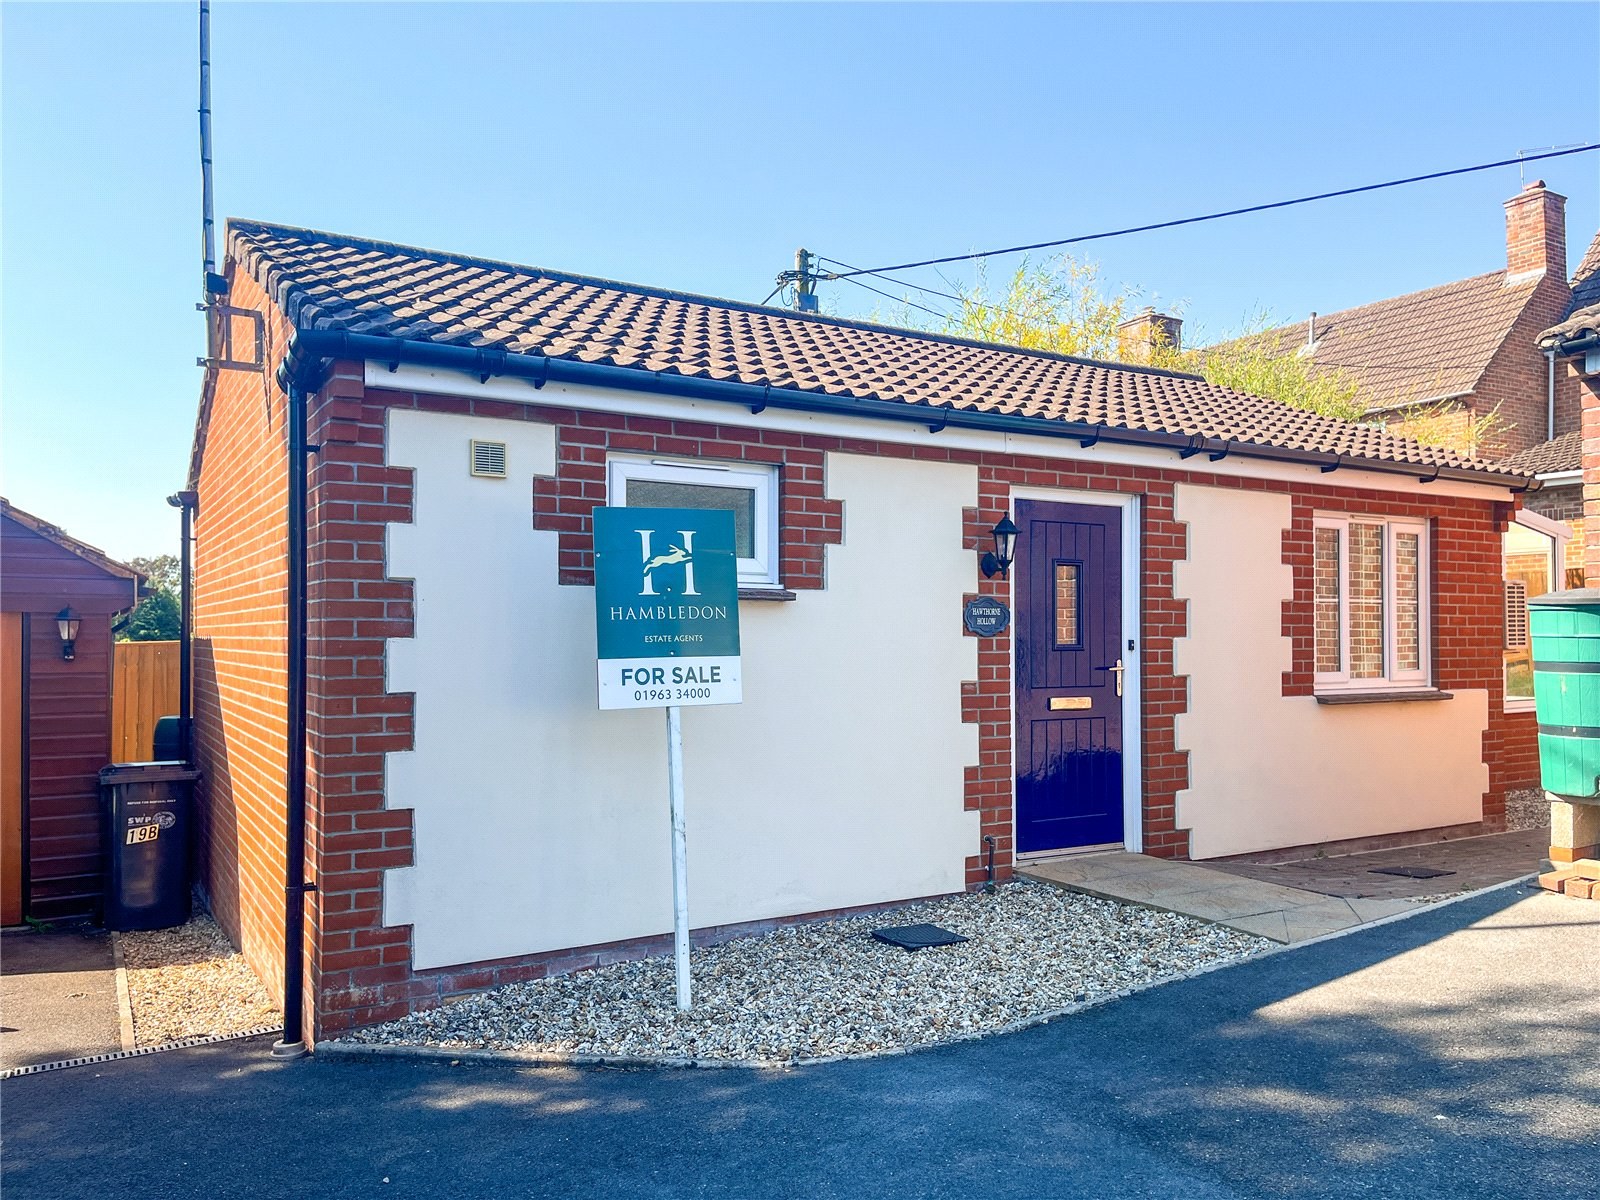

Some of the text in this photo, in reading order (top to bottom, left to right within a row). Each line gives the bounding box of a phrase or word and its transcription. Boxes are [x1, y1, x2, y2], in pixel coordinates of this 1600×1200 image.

[610, 606, 727, 621] HAMBLEDON
[972, 607, 1001, 616] HAWTHORNE
[976, 617, 996, 625] HOLLOW
[644, 634, 703, 643] ESTATE AGENTS
[621, 665, 721, 686] FOR SALE
[634, 687, 711, 701] 01963 34000
[130, 826, 157, 843] 19B
